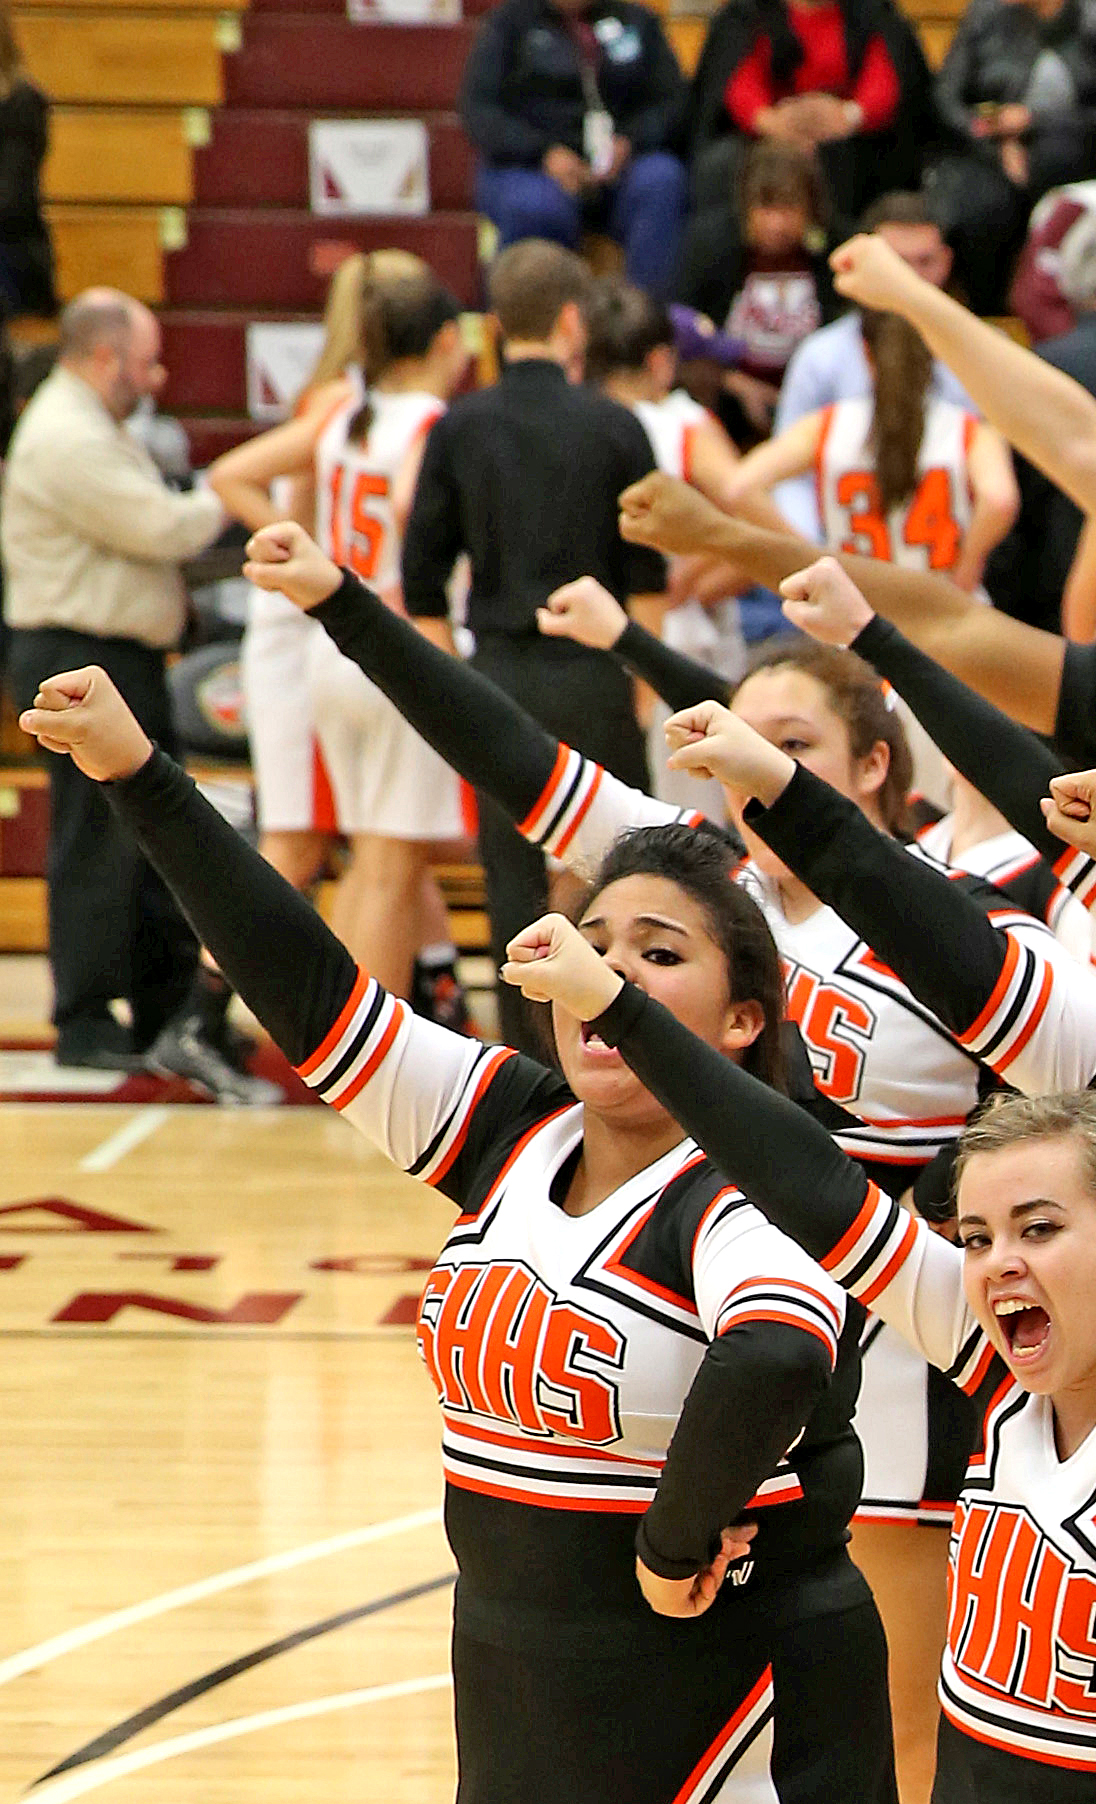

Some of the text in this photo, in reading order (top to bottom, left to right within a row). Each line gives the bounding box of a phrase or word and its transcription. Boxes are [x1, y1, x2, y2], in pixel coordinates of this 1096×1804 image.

[330, 464, 389, 579] 15
[838, 468, 963, 571] 34
[416, 1259, 628, 1446] SHHS
